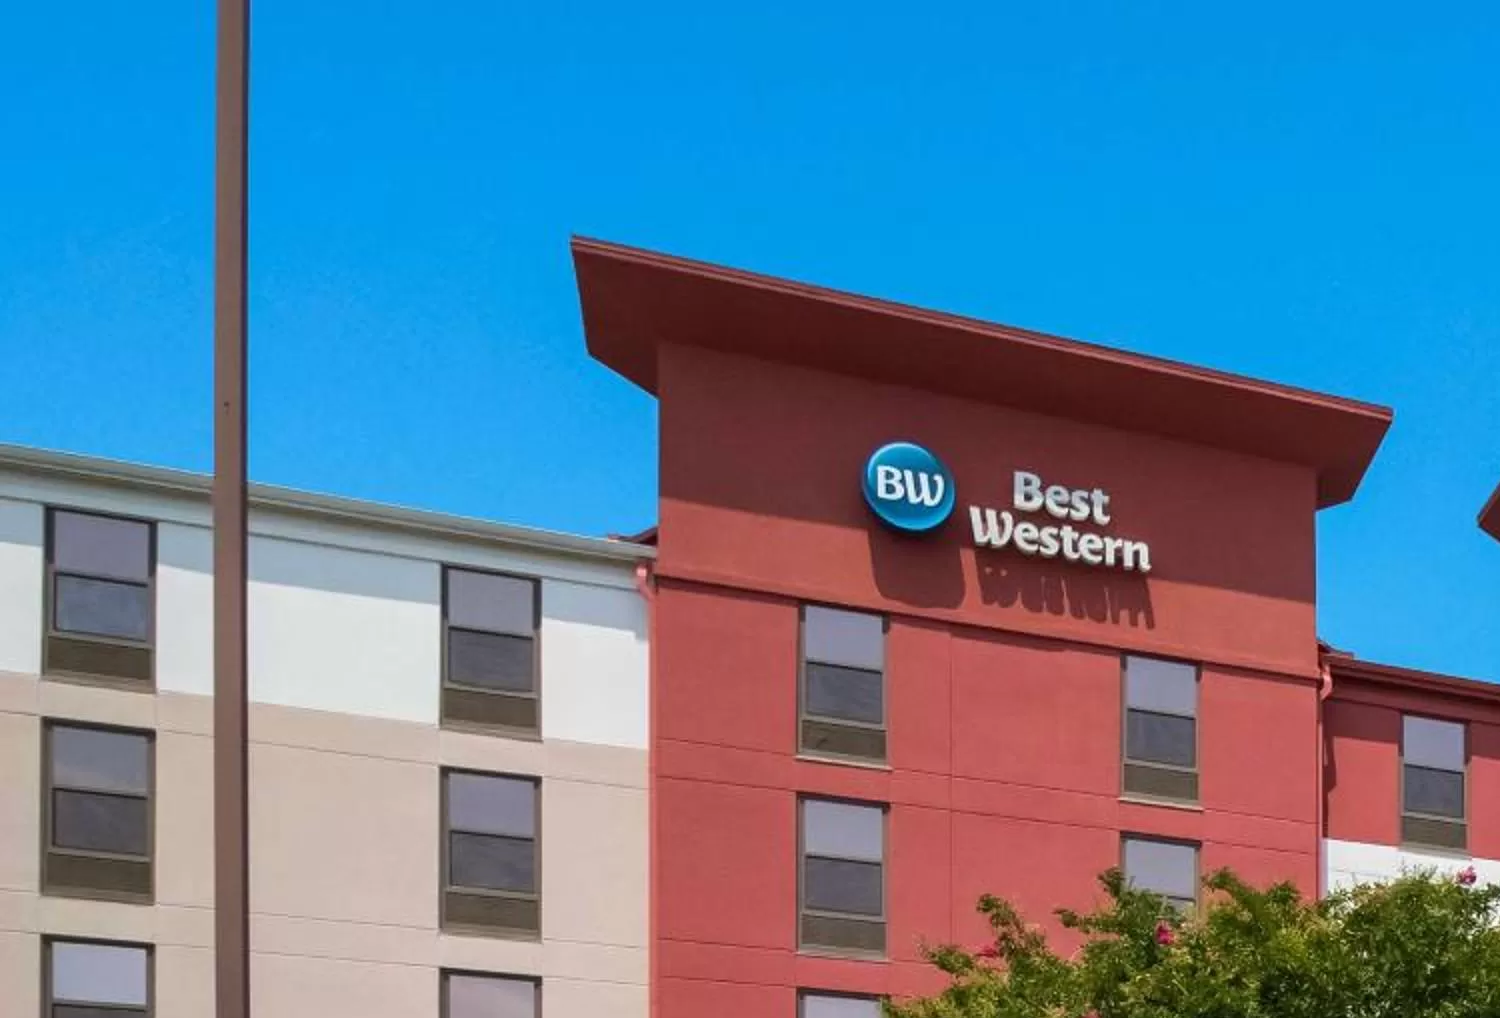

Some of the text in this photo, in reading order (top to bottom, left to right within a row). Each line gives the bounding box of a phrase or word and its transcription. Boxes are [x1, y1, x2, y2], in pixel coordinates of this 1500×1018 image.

[876, 465, 945, 507] BW
[1013, 471, 1110, 525] Best
[969, 506, 1151, 572] Western
